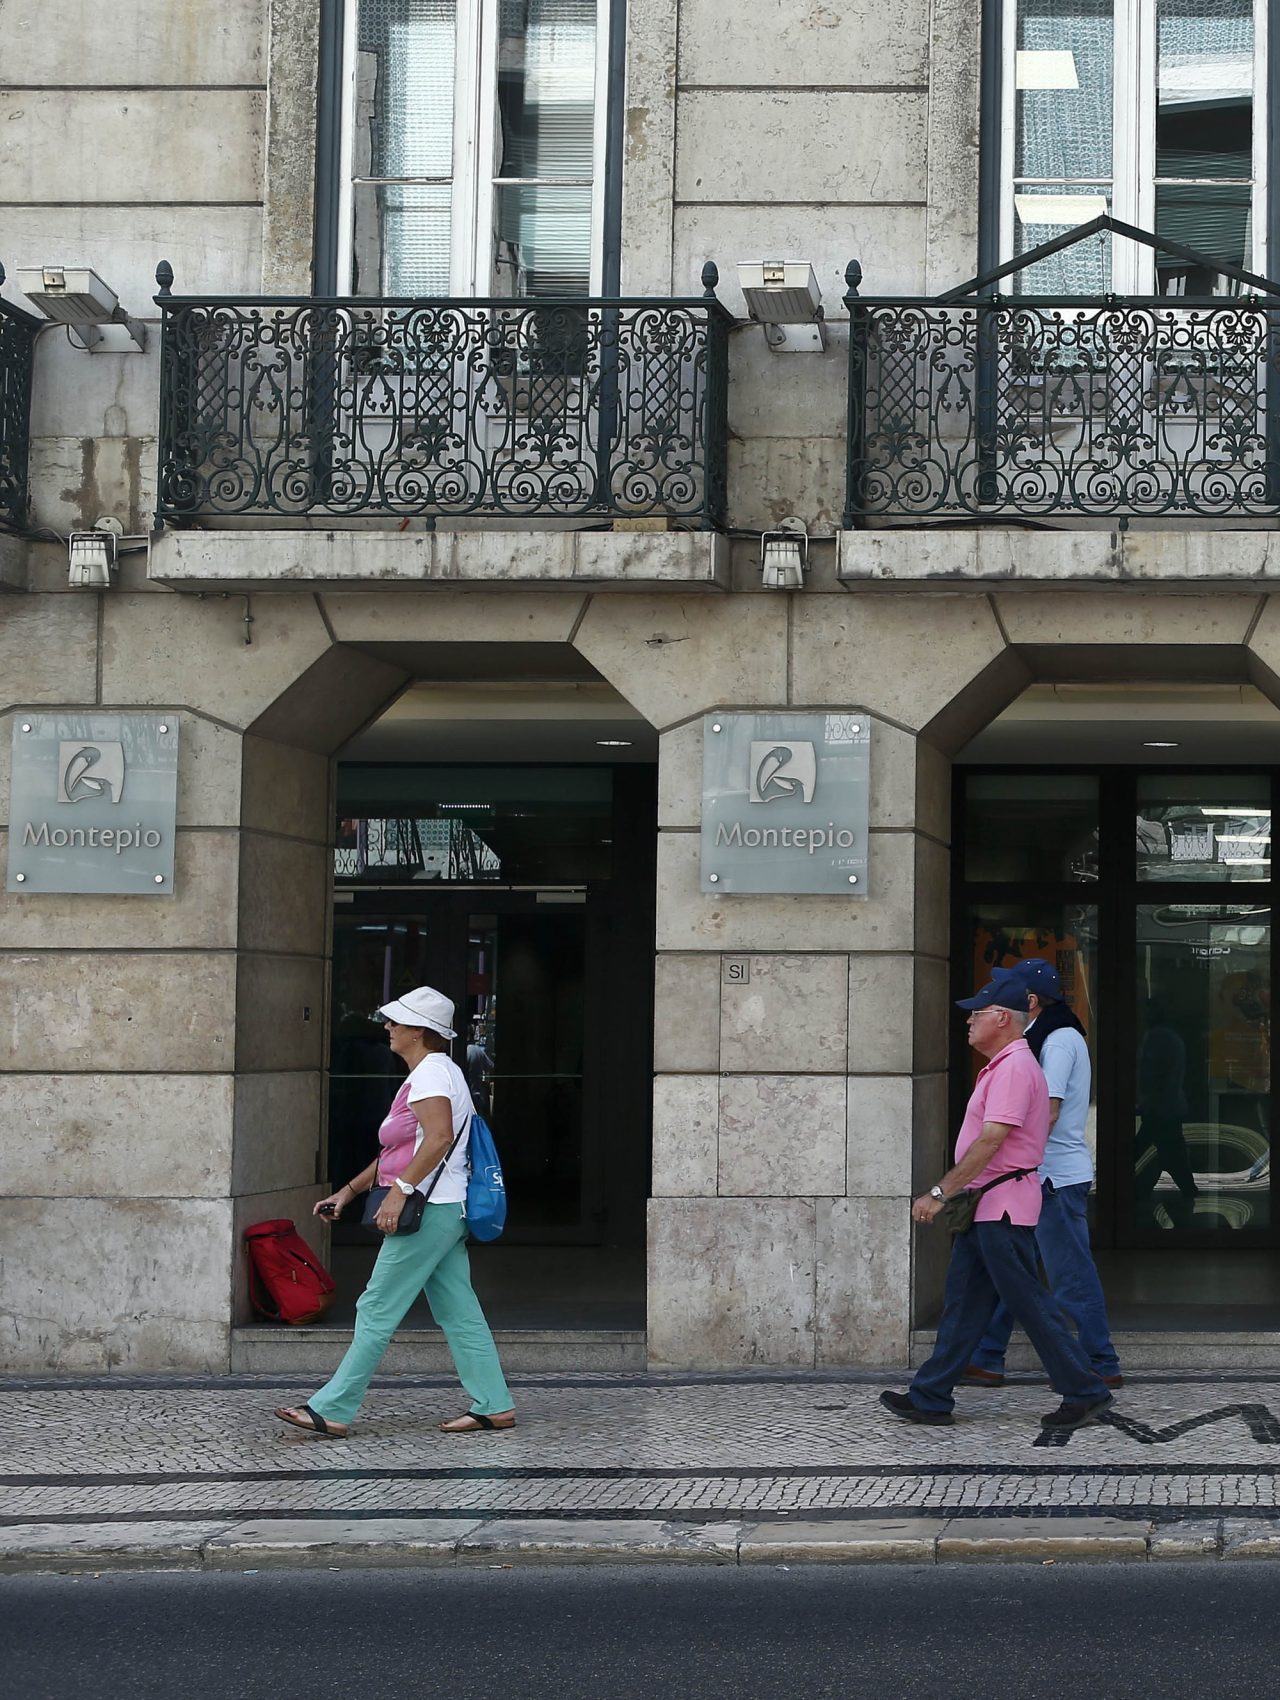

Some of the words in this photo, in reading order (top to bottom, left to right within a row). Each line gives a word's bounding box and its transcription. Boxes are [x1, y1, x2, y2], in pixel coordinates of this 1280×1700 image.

[22, 821, 161, 854] Montepio
[715, 822, 854, 855] Montepio
[729, 964, 744, 979] SI
